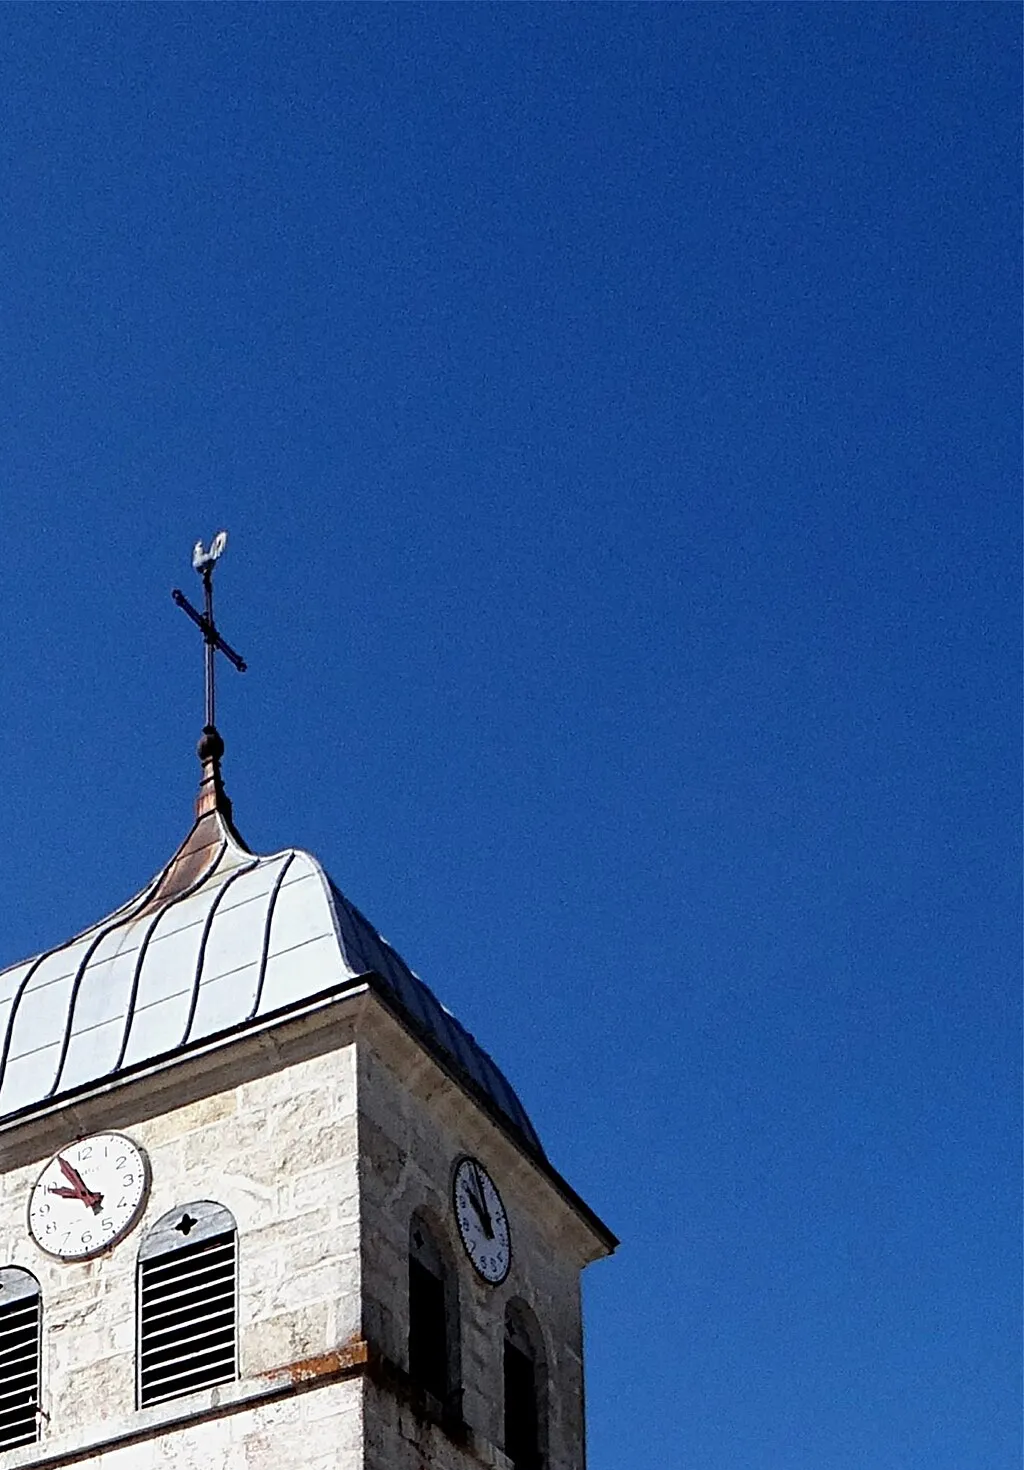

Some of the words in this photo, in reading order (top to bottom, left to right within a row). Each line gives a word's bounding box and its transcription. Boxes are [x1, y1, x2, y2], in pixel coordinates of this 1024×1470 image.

[78, 1146, 93, 1162] 12
[104, 1146, 108, 1158] 1
[115, 1156, 127, 1170] 2
[123, 1174, 134, 1187] 3
[116, 1196, 127, 1209] 4
[39, 1204, 51, 1217] 9
[45, 1221, 57, 1235] 8
[101, 1217, 114, 1231] 5
[61, 1231, 72, 1245] 7
[81, 1230, 93, 1244] 6
